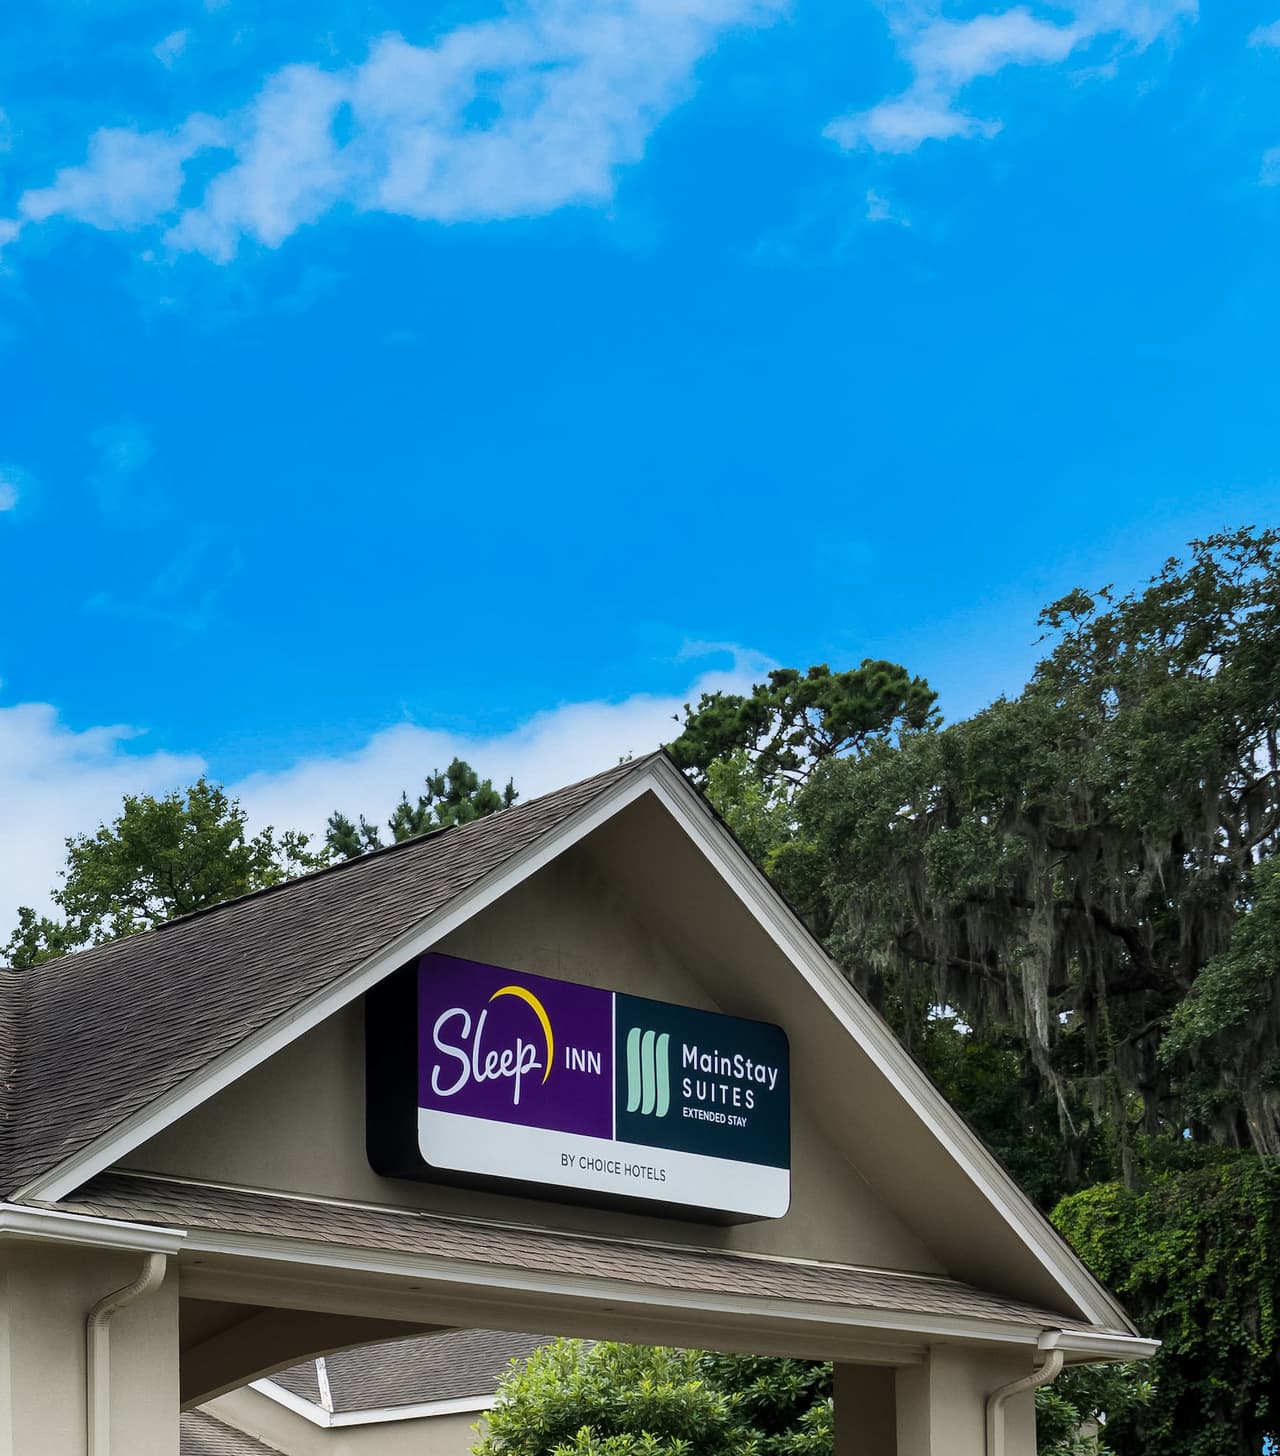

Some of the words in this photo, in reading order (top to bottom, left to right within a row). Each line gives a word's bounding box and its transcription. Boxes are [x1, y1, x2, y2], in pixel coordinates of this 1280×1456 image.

[431, 1007, 542, 1105] Sleep
[565, 1046, 601, 1075] INN
[682, 1043, 778, 1091] MainStay
[682, 1078, 755, 1109] SUITES
[682, 1106, 726, 1124] EXTENDED
[727, 1114, 747, 1127] STAY
[561, 1153, 576, 1167] BY
[579, 1156, 621, 1175] CHOICE
[624, 1163, 666, 1182] HOTELS
